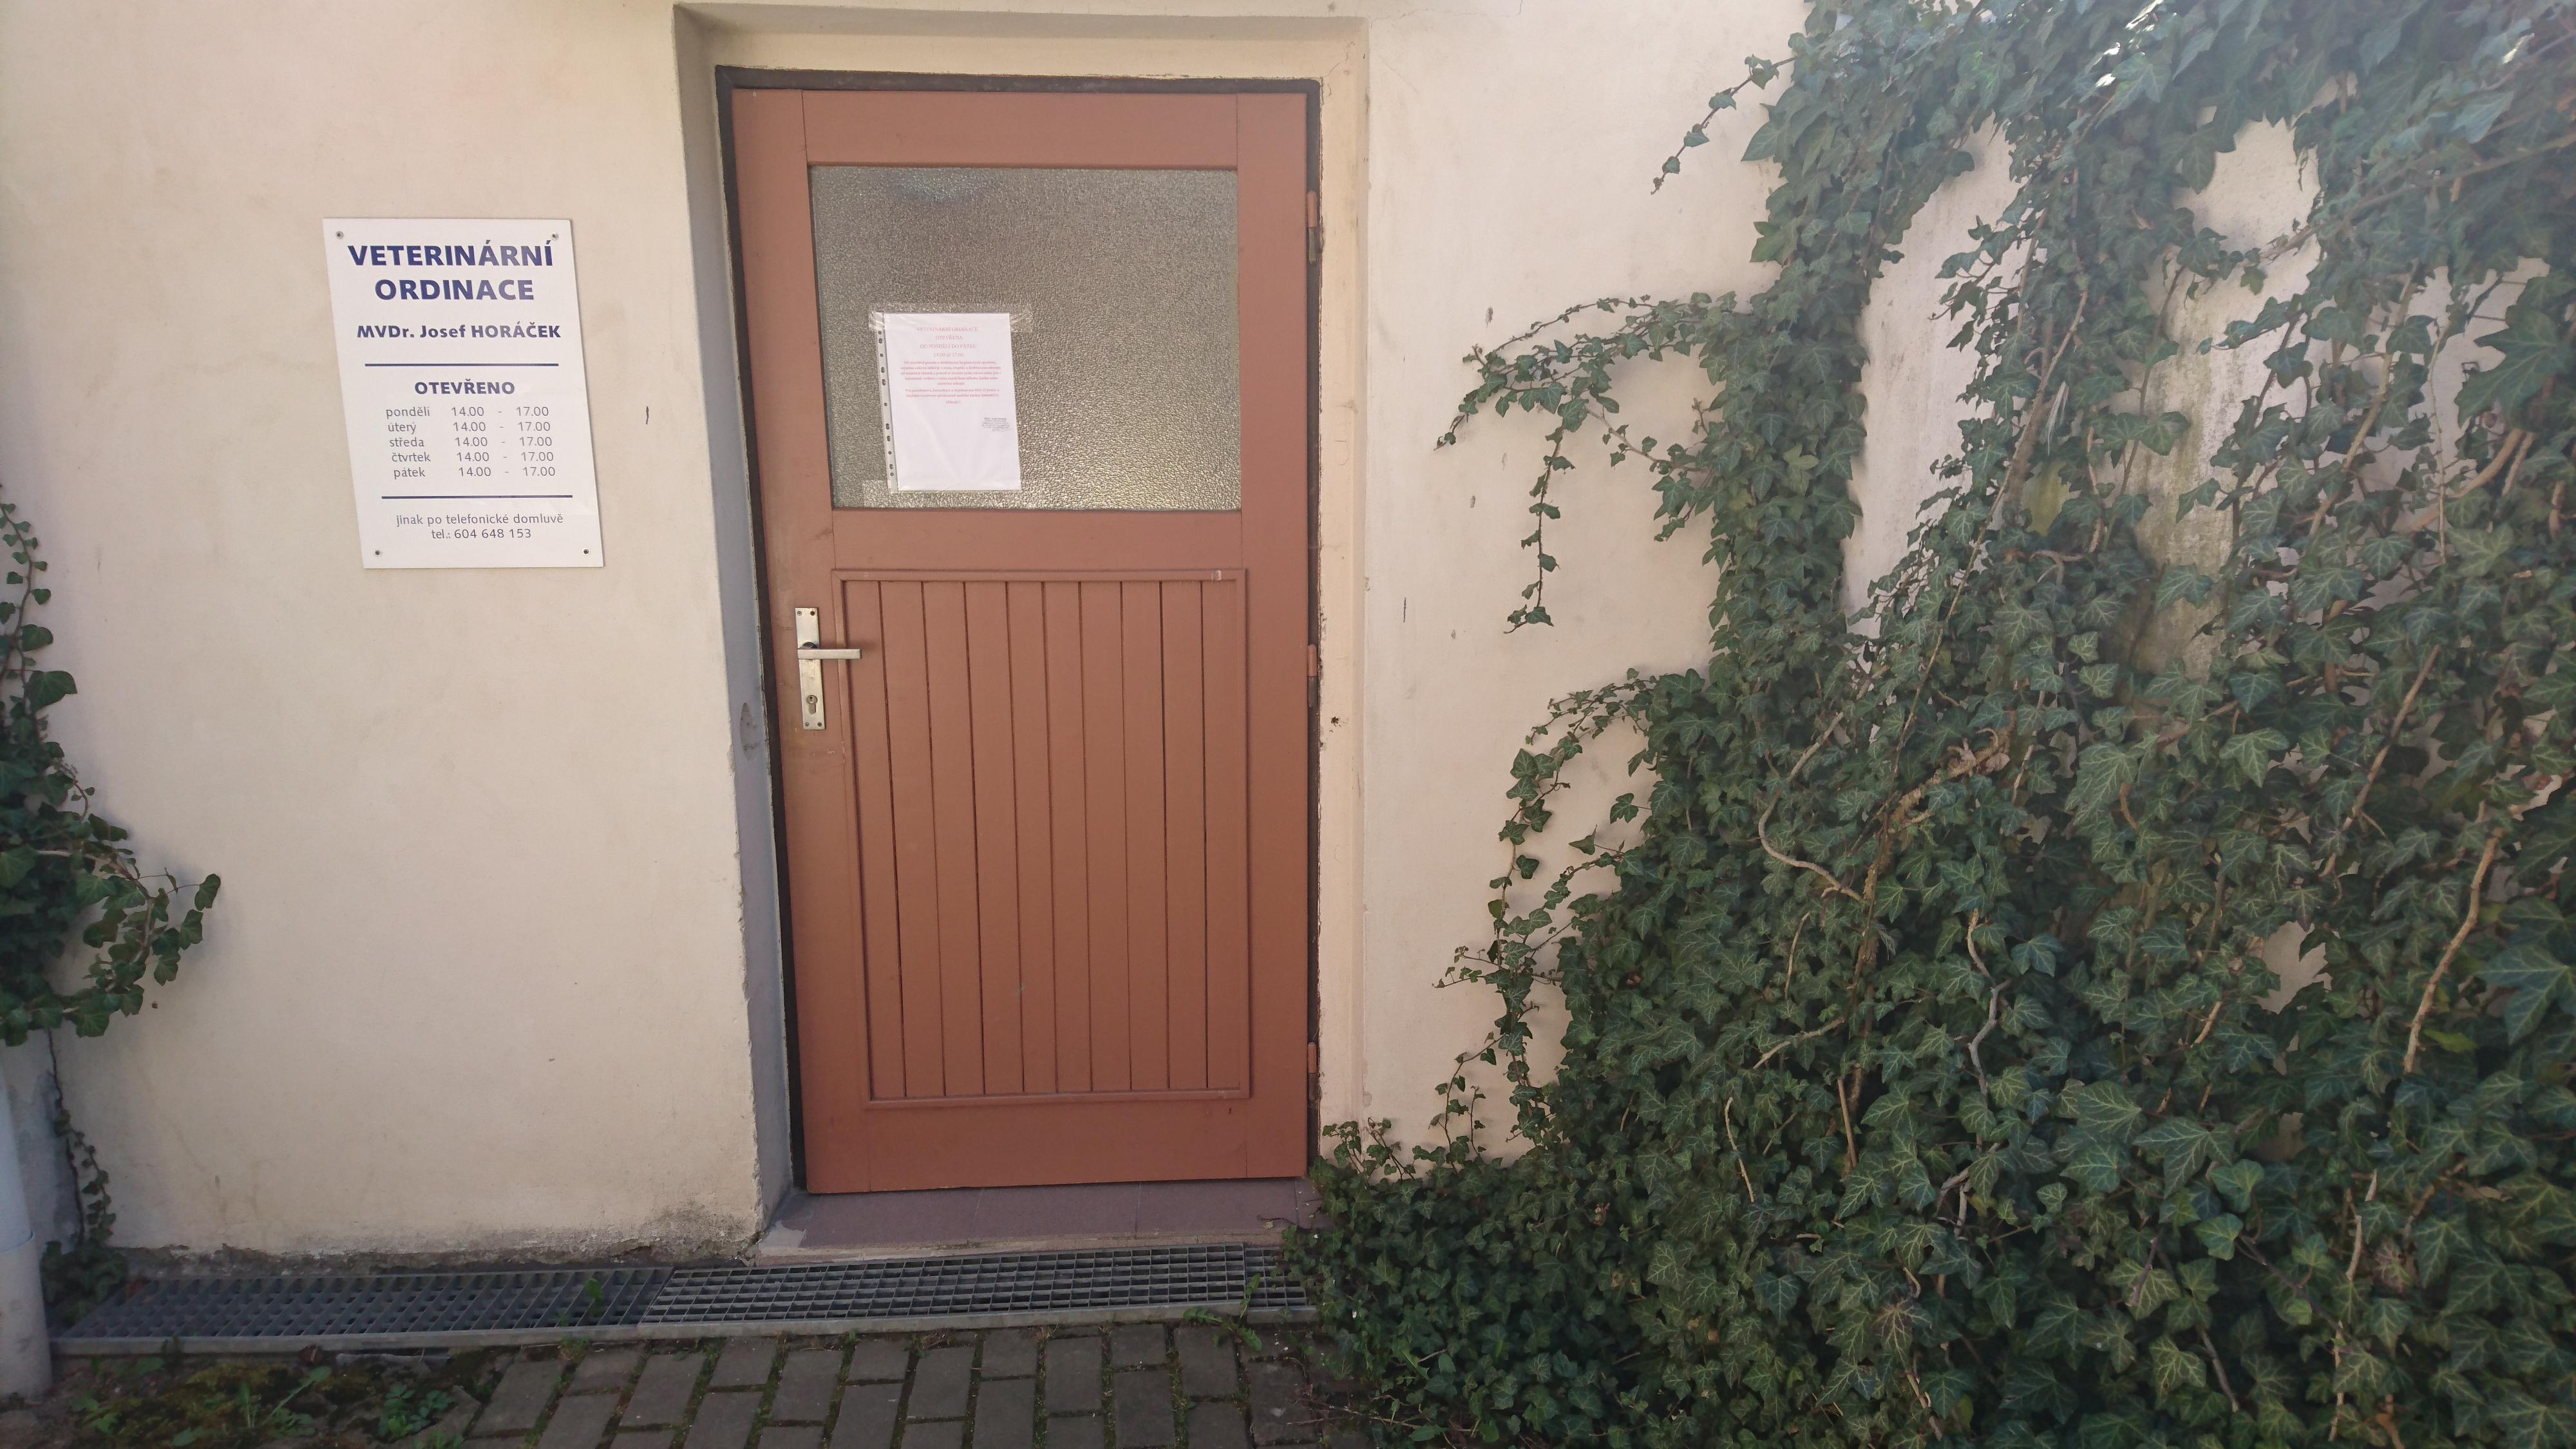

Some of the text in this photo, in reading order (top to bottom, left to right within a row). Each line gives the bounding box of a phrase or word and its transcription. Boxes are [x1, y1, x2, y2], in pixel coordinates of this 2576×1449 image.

[347, 240, 553, 267] VETERINÁRNÍ
[375, 278, 535, 301] ORDINACE
[357, 321, 562, 339] MVDr. Josef HORÁČEK
[414, 378, 515, 395] OTEVŘENO
[451, 406, 485, 417] 14.00
[515, 406, 549, 417] 17.00
[386, 421, 417, 433] úterý
[453, 421, 486, 432] 14.00
[517, 421, 552, 432] 17.00
[389, 437, 425, 448] středa
[455, 437, 488, 447] 14.00
[519, 437, 553, 447] 17.00
[391, 451, 431, 463] čtvrtek
[457, 451, 490, 462] 14.00
[520, 451, 554, 462] 17.00
[393, 467, 426, 480] pátek
[458, 466, 491, 477] 14.00
[522, 466, 556, 477] 17.00
[395, 513, 564, 527] jinak po telefonické domluvě
[454, 529, 478, 539] 604
[481, 528, 505, 539] 648
[509, 528, 531, 538] 153
